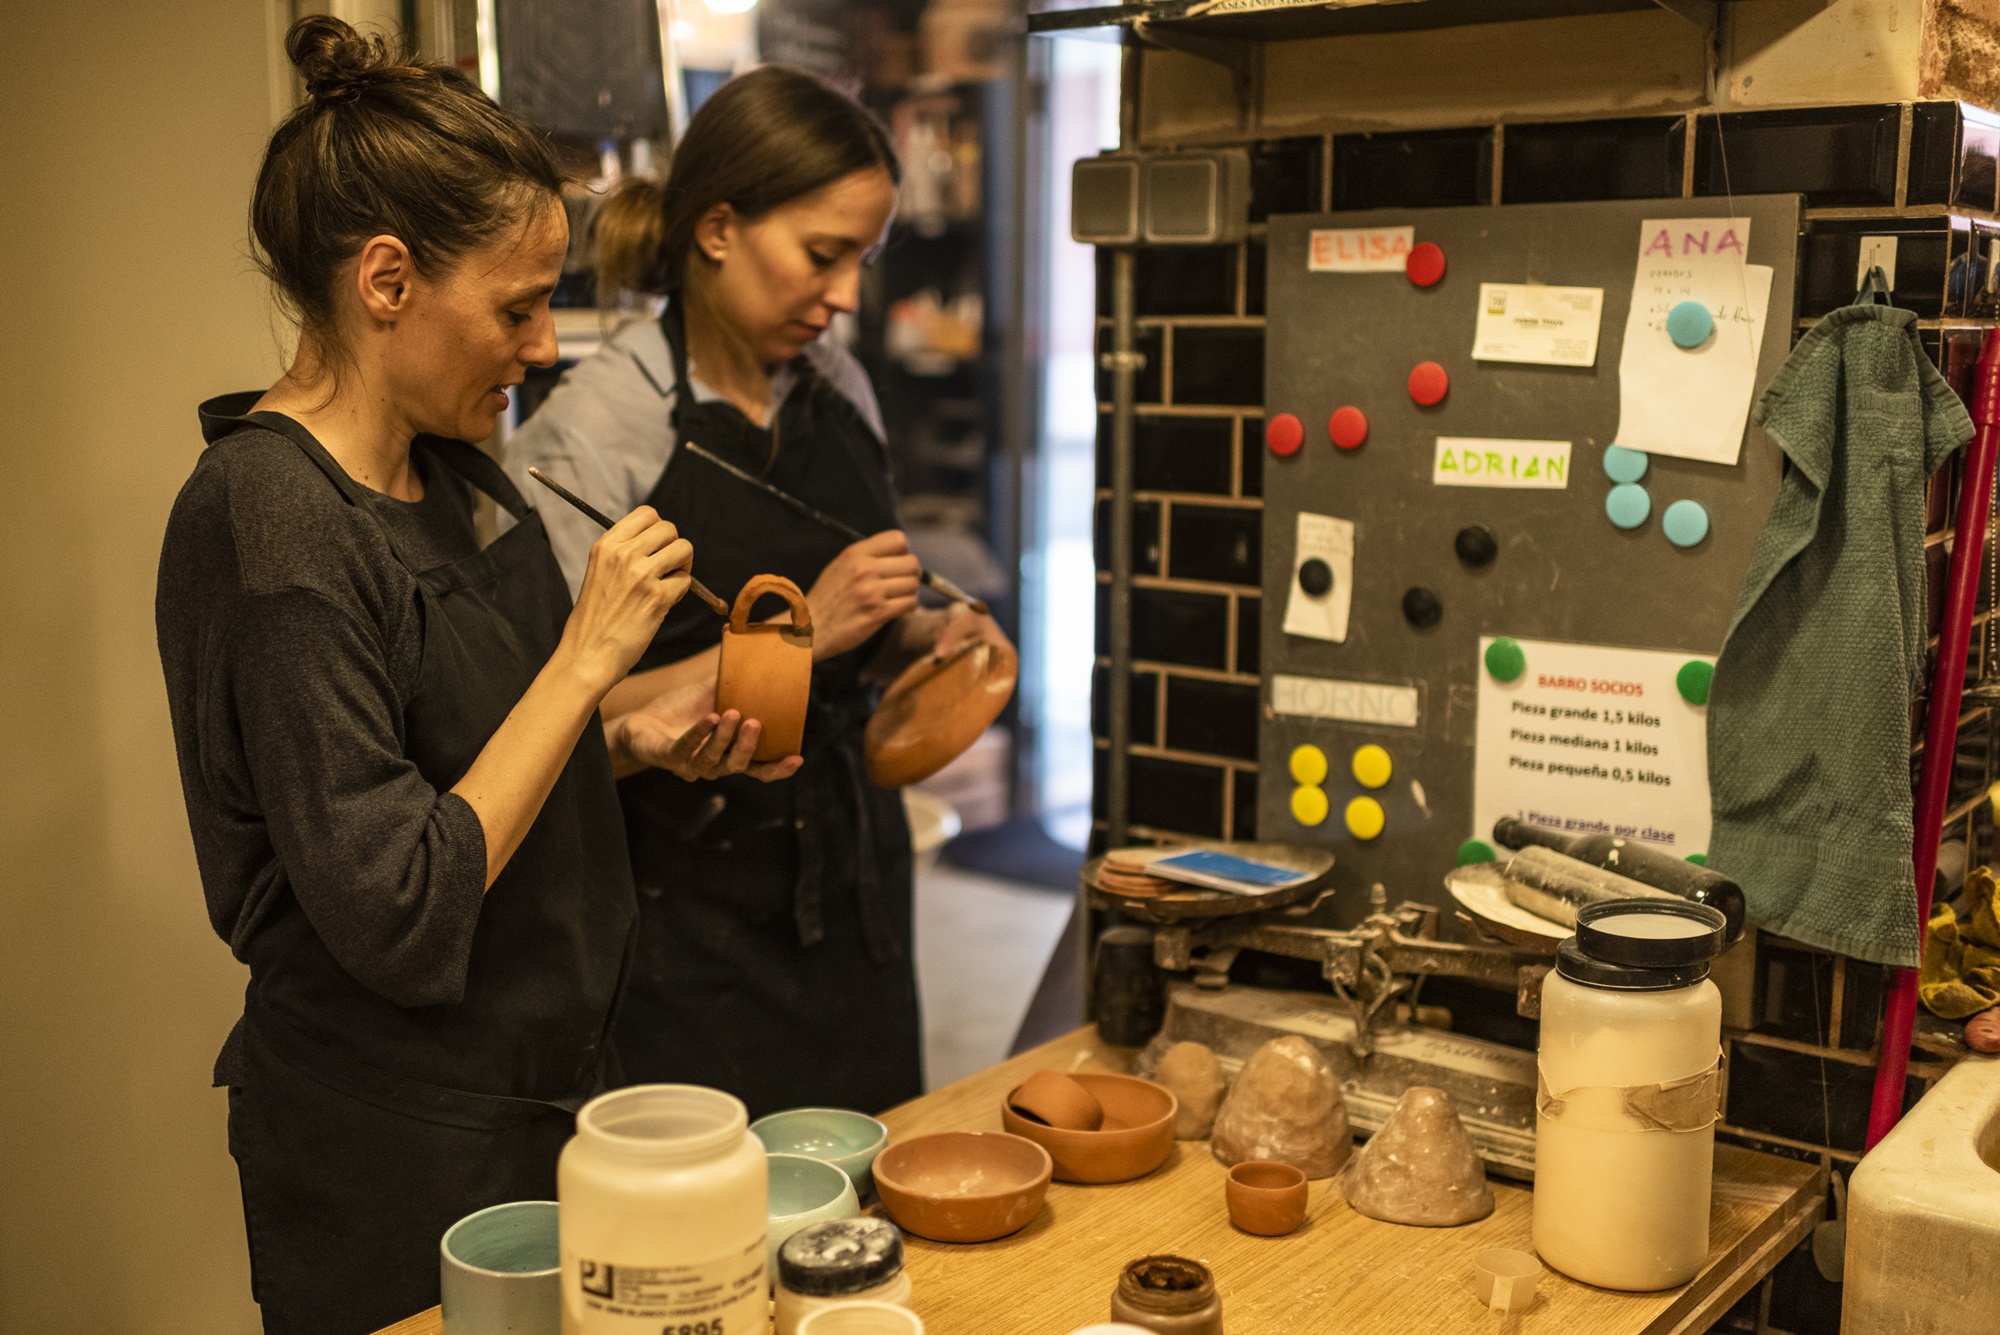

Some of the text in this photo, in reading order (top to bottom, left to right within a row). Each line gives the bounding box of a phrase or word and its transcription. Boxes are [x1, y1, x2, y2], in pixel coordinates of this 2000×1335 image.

[1313, 233, 1409, 264] ELISA
[1644, 228, 1744, 258] ANA
[1439, 447, 1565, 482] ADRIAN
[1275, 679, 1415, 724] HORNO
[1537, 674, 1645, 698] BARRO SOCIOS
[1511, 700, 1661, 728] Pieza grande 1,5 kilos
[1510, 728, 1659, 756] Pieza mediana 1 kilos
[1509, 755, 1672, 787] Pieza pequeña 0,5 kilos
[1528, 810, 1562, 827] Pieza
[1565, 818, 1611, 834] grande
[1614, 824, 1638, 838] por
[1640, 826, 1676, 843] clase
